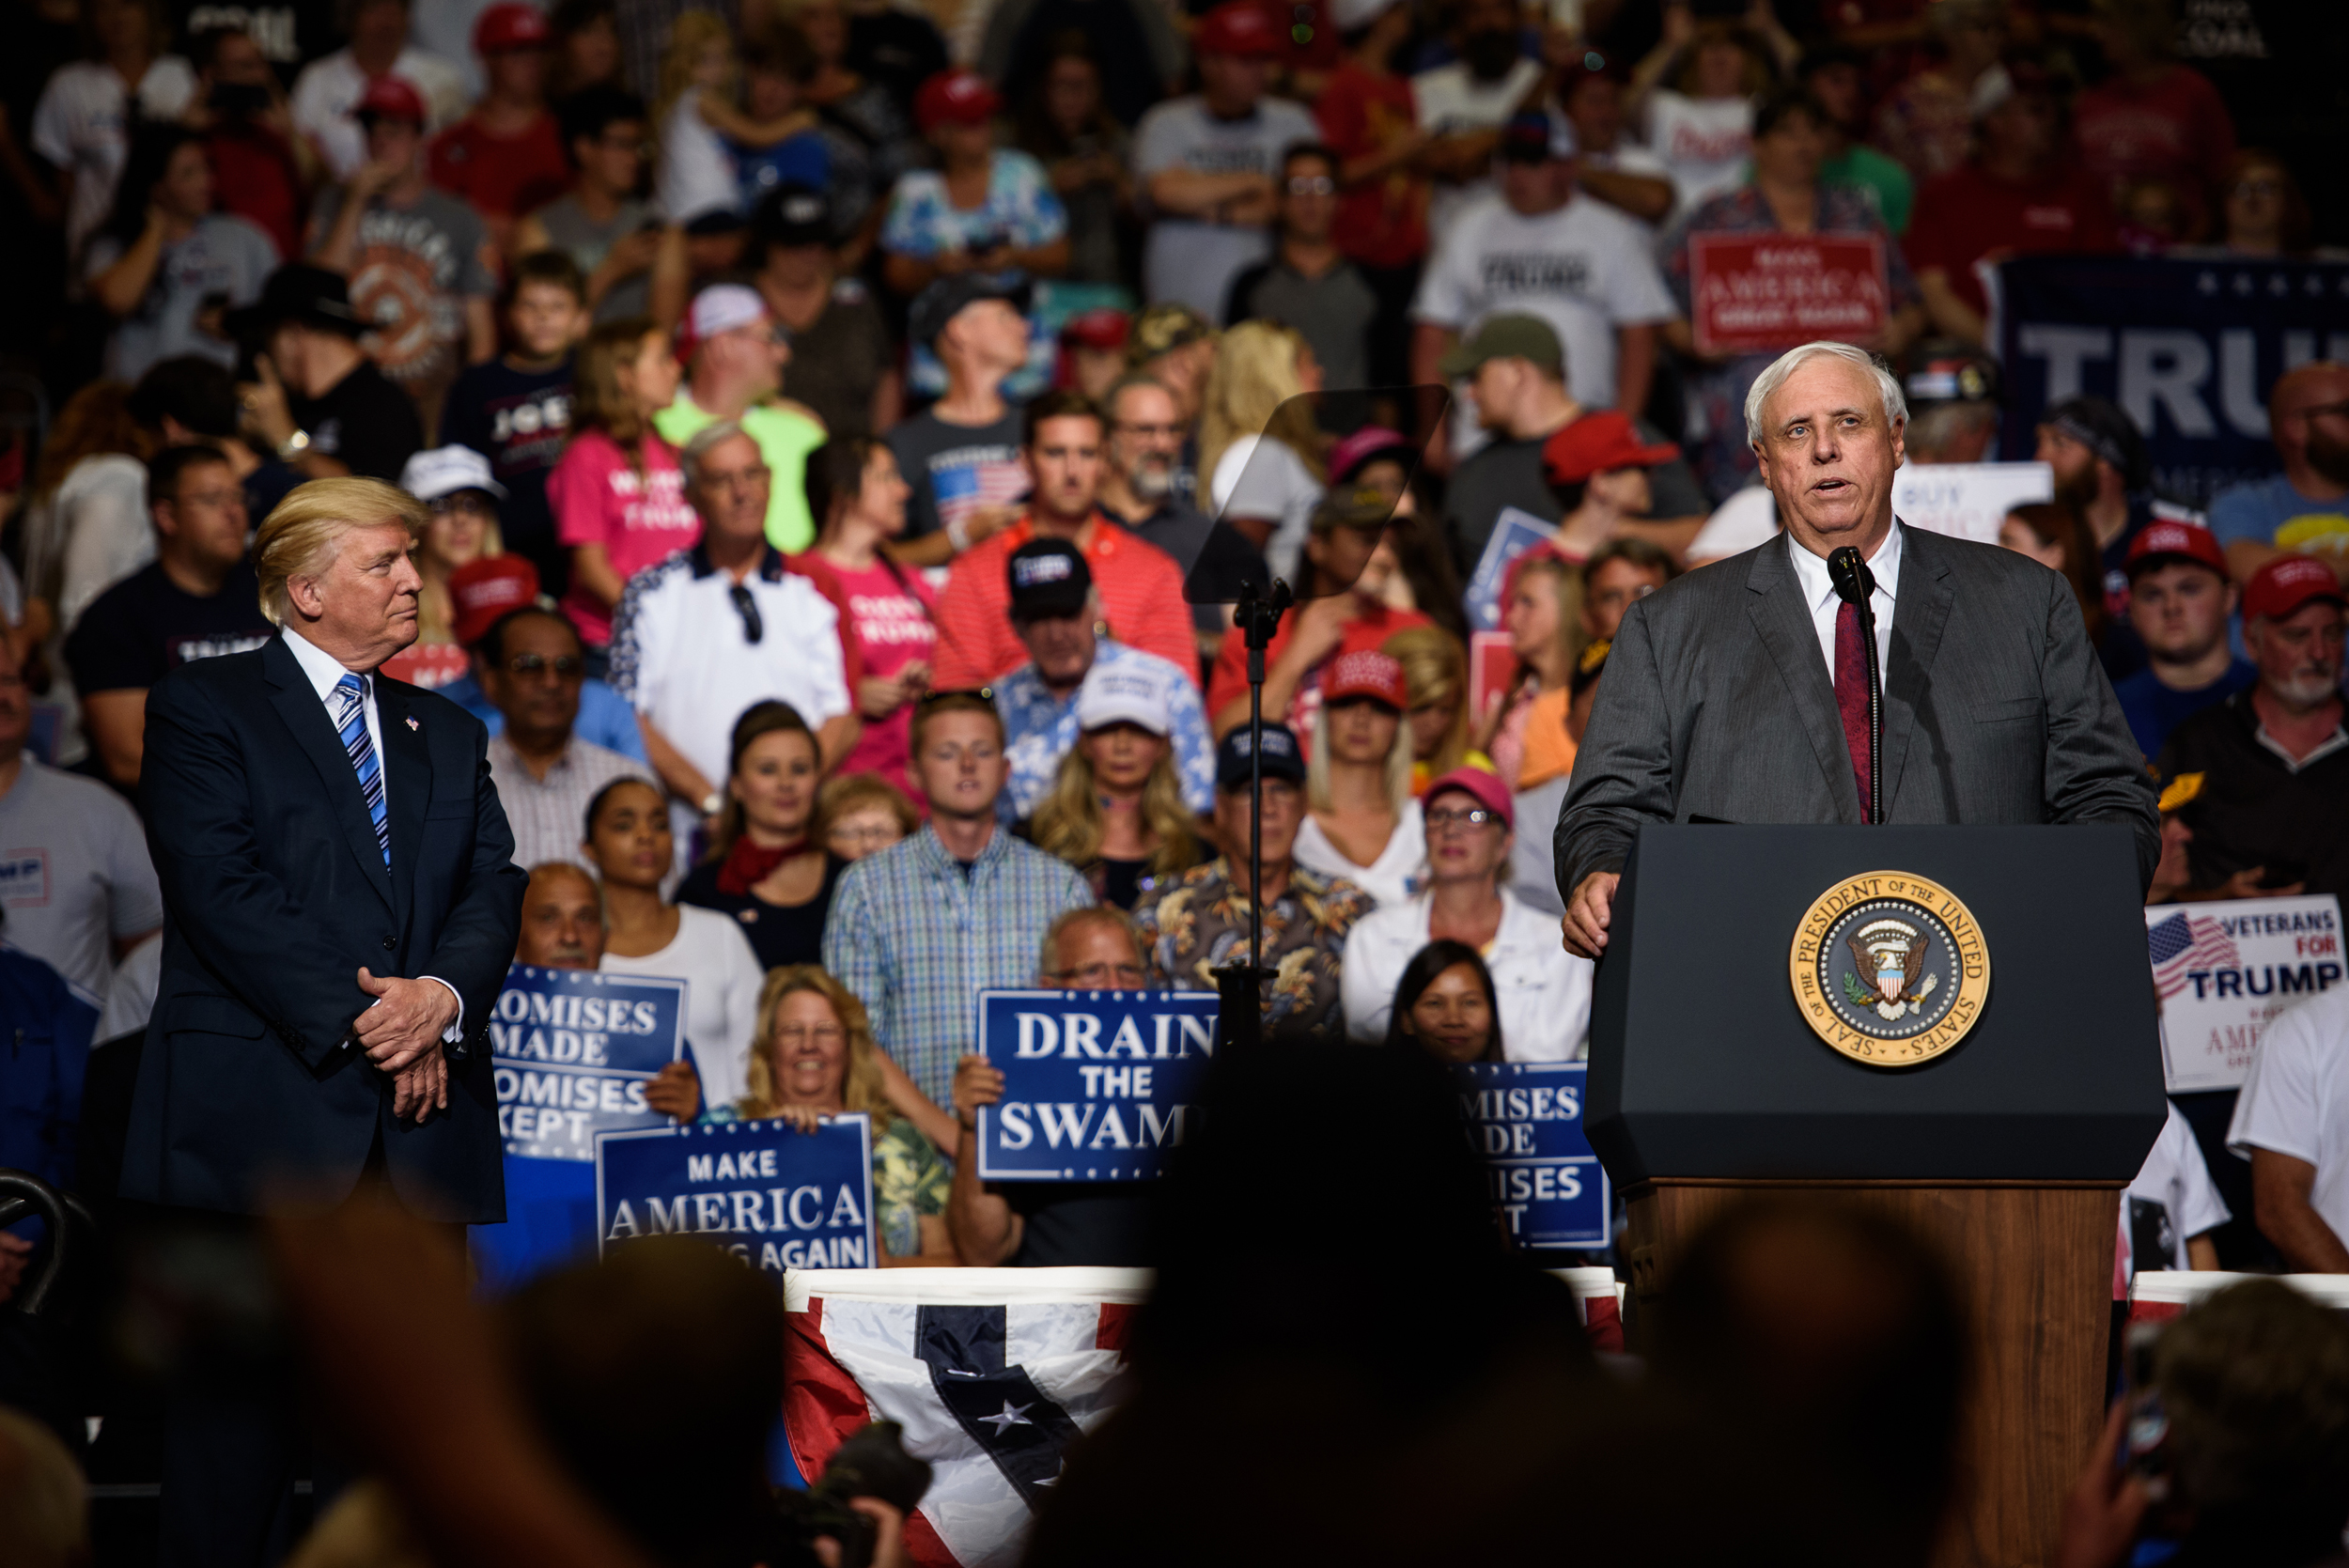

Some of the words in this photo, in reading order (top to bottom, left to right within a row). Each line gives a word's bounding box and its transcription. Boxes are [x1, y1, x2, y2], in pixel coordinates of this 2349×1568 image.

[1889, 880, 1906, 892] OF
[1910, 884, 1936, 903] THE
[1797, 878, 1882, 964] PRESIDENT
[2222, 910, 2335, 936] VETERANS
[1939, 901, 1983, 979] UNITED
[2295, 936, 2338, 956] FOR
[1800, 971, 1815, 998] THE
[2187, 961, 2341, 998] TRUMP
[490, 988, 658, 1036] OMISES
[1809, 1000, 1825, 1017] OF
[1910, 997, 1975, 1056] STATES
[490, 1021, 610, 1066] MADE
[1013, 1012, 1219, 1061] DRAIN
[1825, 1016, 1875, 1056] SEAL
[494, 1067, 650, 1114] OMISES
[1079, 1065, 1154, 1099] THE
[1459, 1086, 1580, 1121] MISES
[1000, 1101, 1195, 1150] SWAM
[687, 1149, 779, 1183] MAKE
[605, 1183, 865, 1240] AMERICA
[759, 1234, 866, 1270] AGAIN
